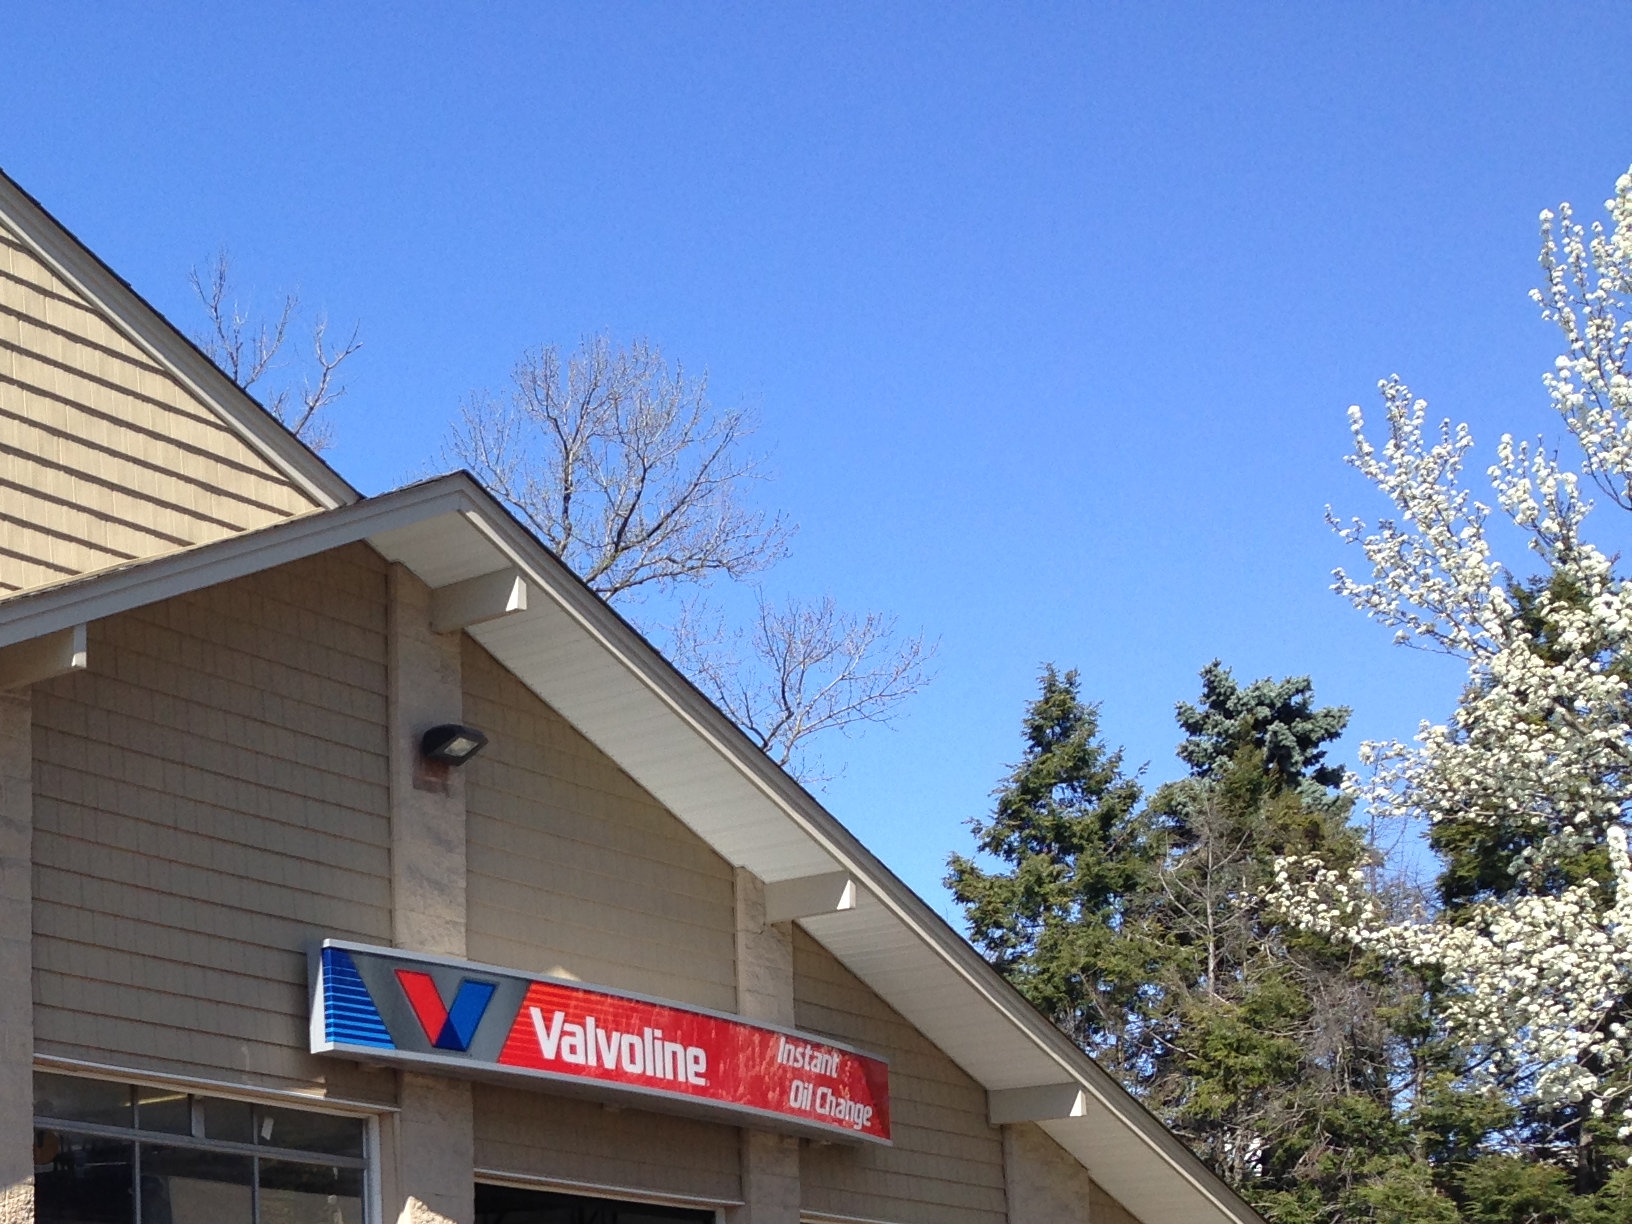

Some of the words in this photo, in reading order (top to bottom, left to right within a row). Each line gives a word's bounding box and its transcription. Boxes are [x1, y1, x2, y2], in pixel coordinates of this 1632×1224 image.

[529, 1006, 709, 1087] Valvoline
[777, 1036, 840, 1079] Instant
[789, 1079, 814, 1111] Oil
[815, 1086, 873, 1130] Change
